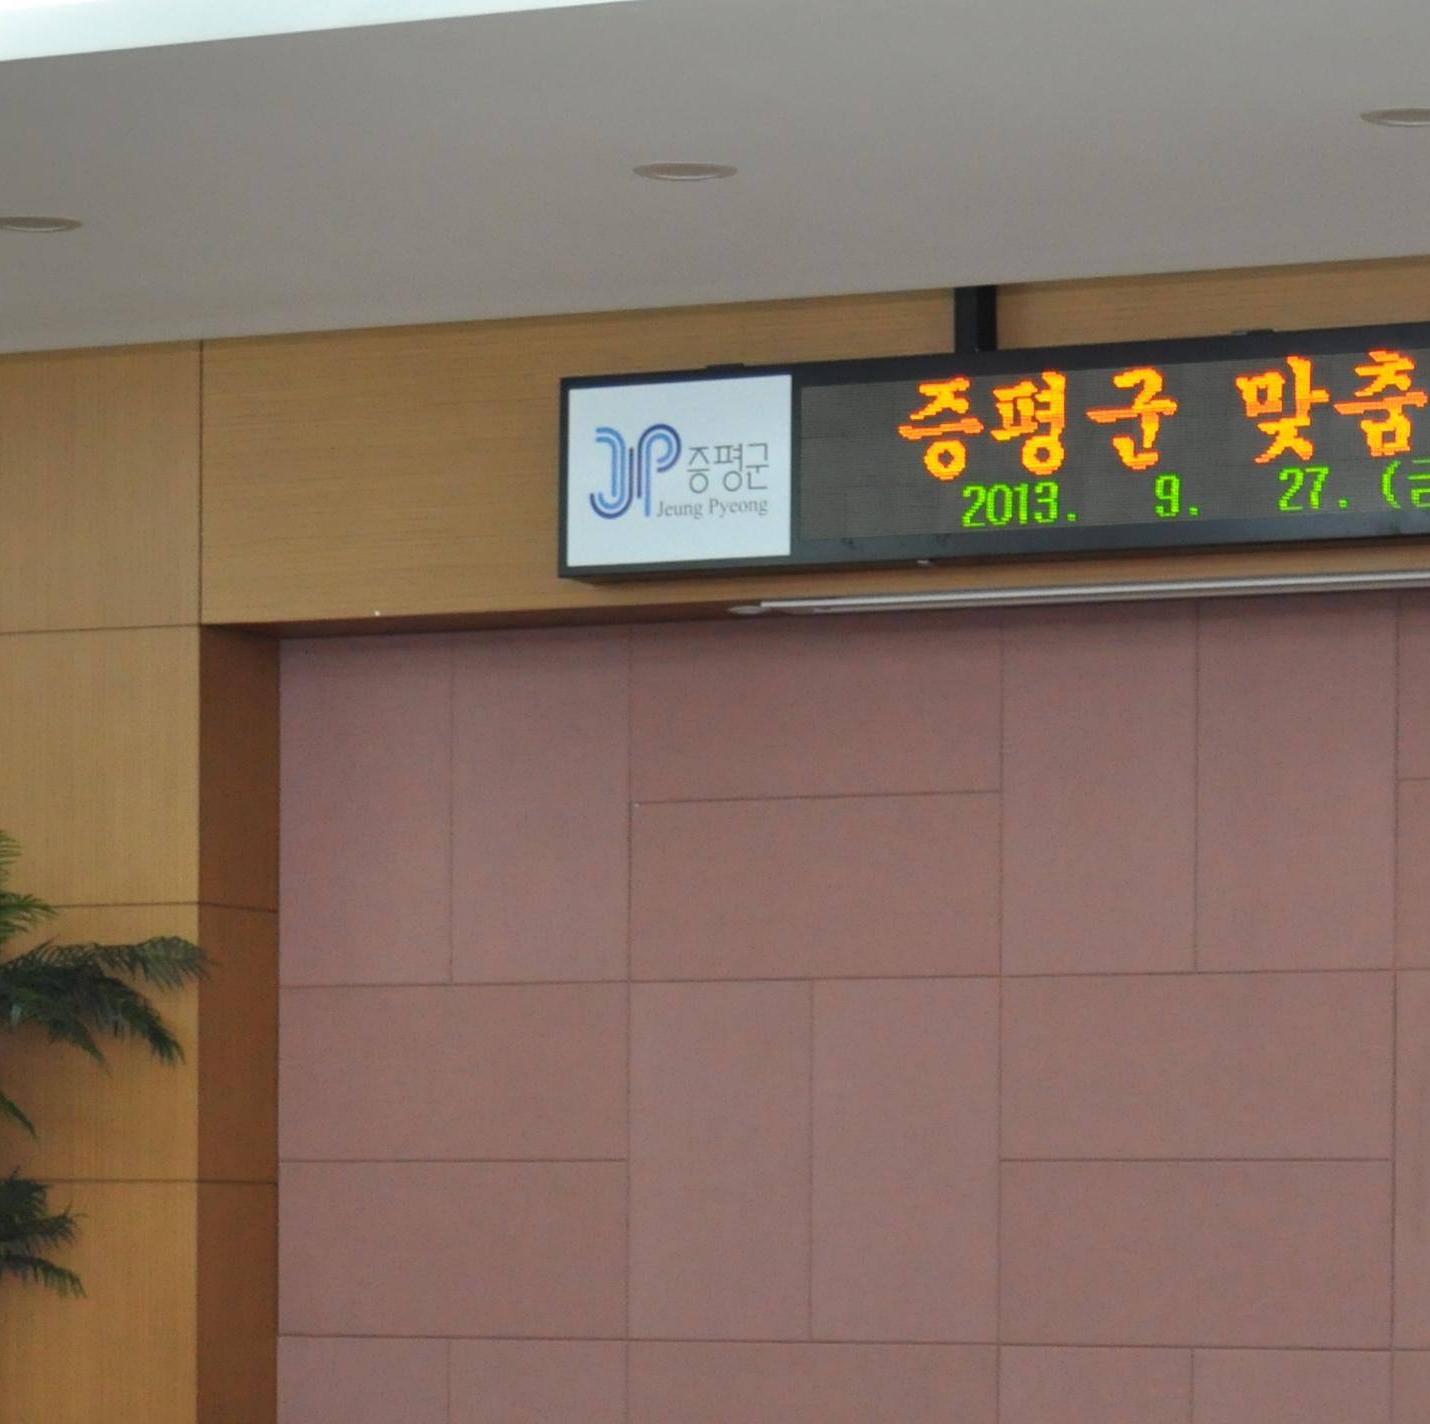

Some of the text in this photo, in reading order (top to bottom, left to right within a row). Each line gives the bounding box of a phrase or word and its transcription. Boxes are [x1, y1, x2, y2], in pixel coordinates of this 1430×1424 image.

[898, 366, 1178, 481] 증평군
[687, 442, 769, 494] 증평군
[657, 498, 768, 519] Jeung Pyeong
[962, 481, 1077, 528] 2013.
[1155, 474, 1199, 518] 9.
